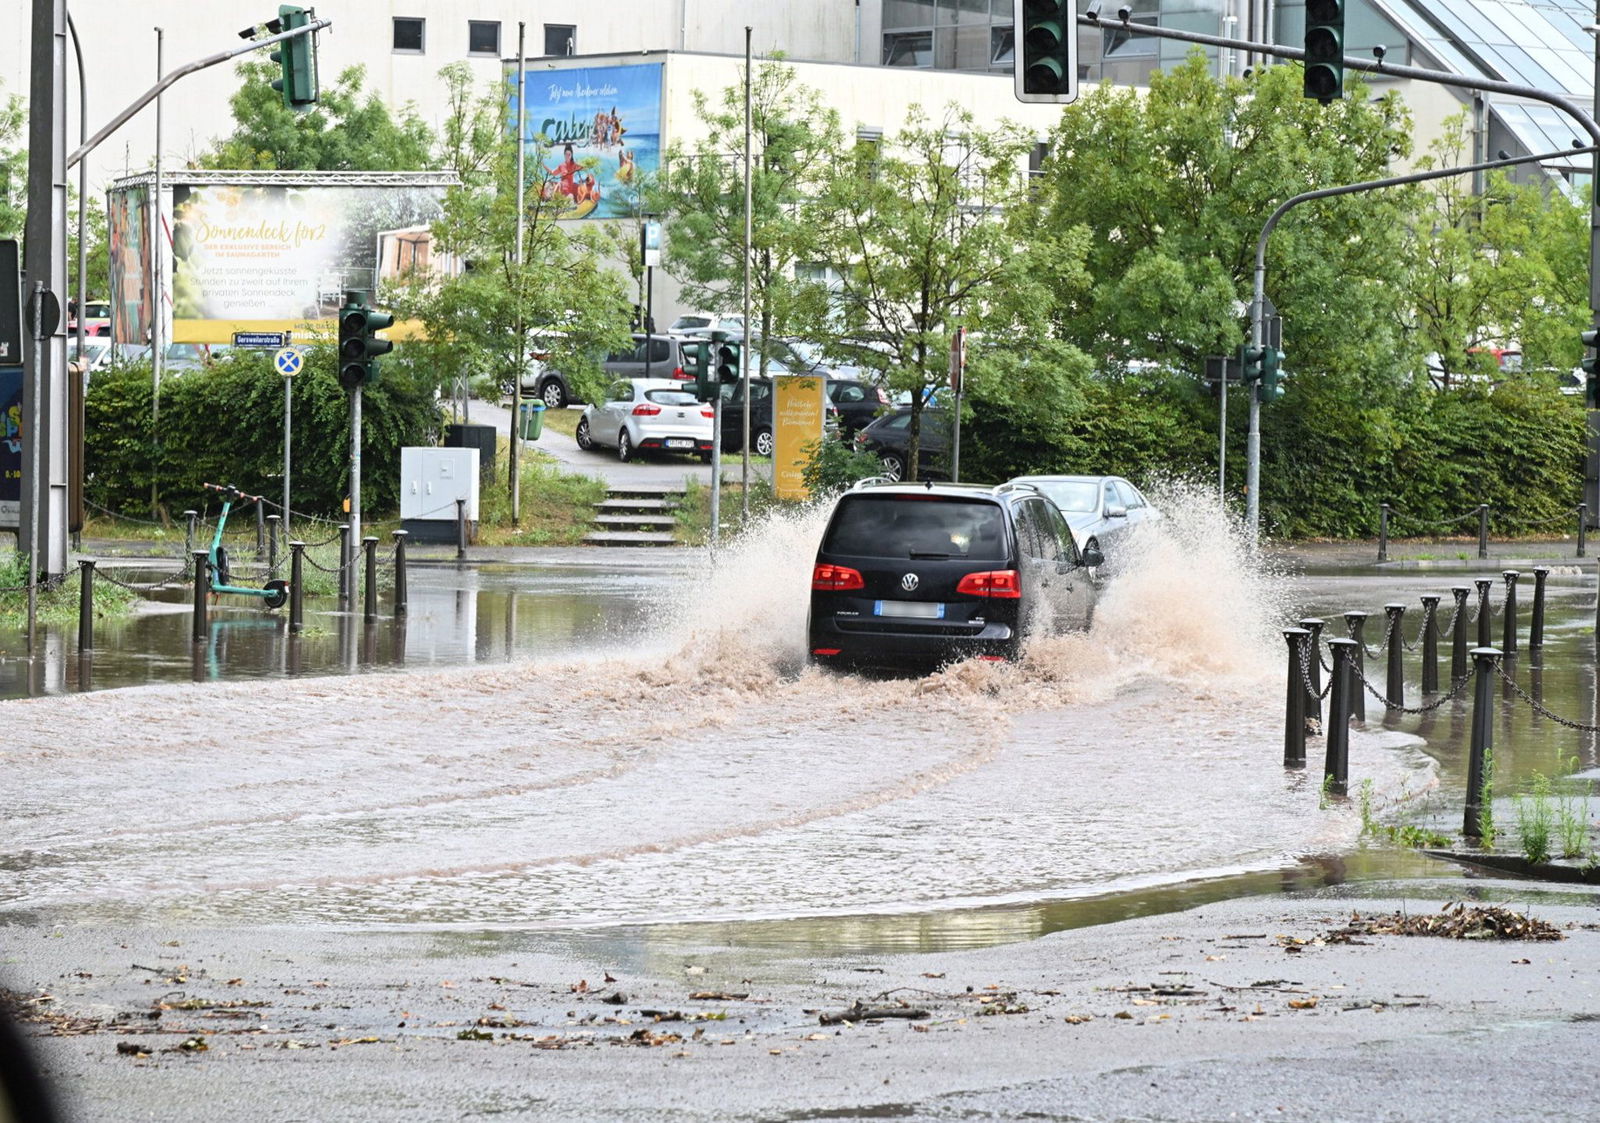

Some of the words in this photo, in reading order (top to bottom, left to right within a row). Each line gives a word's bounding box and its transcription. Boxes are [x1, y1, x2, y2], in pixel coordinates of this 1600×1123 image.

[195, 217, 292, 243] Sonnendeck
[648, 226, 658, 244] P
[202, 266, 223, 275] Jetzt
[190, 277, 226, 286] Stunden
[241, 277, 263, 286] zweit
[266, 277, 281, 286] auf
[202, 287, 239, 298] privaten
[242, 287, 296, 297] Sonnendeck
[224, 298, 266, 309] genießen
